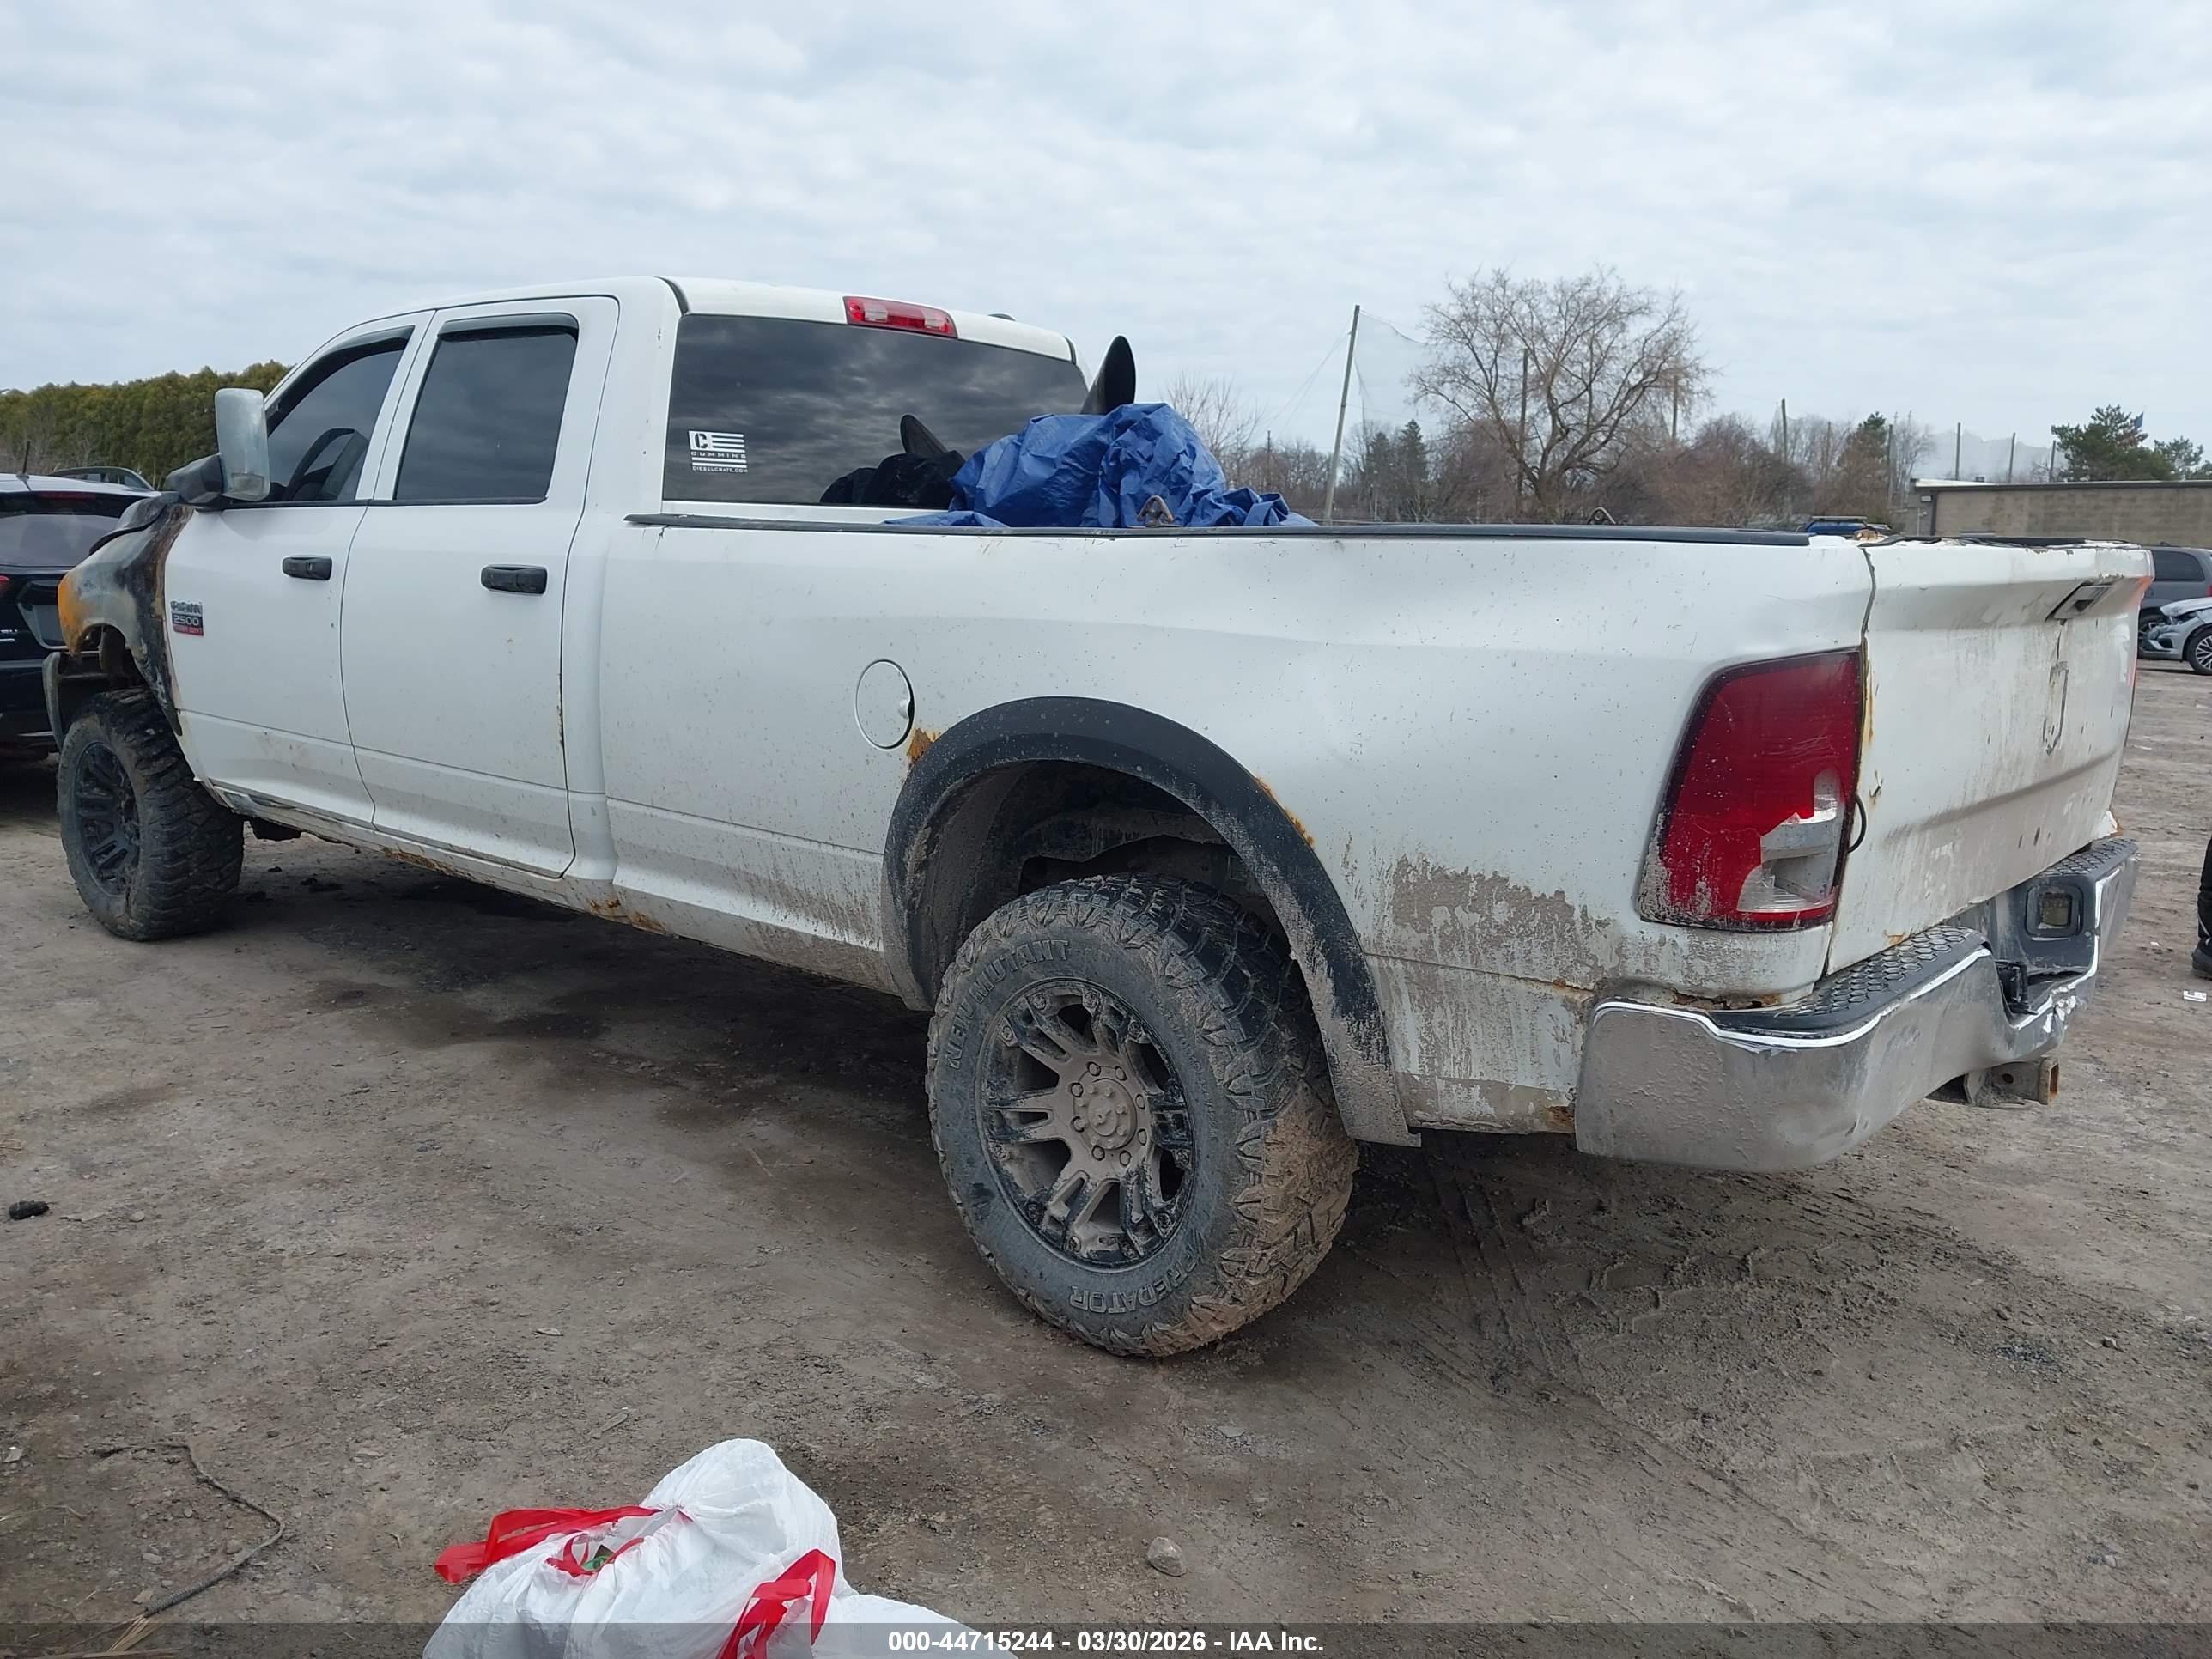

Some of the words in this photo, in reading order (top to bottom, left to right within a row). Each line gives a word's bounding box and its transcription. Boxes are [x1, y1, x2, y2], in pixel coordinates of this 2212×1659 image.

[173, 615, 199, 626] 2500
[945, 997, 976, 1070] NEW
[969, 939, 1070, 1003] MUTANT
[1067, 1243, 1199, 1314] PREDATOR
